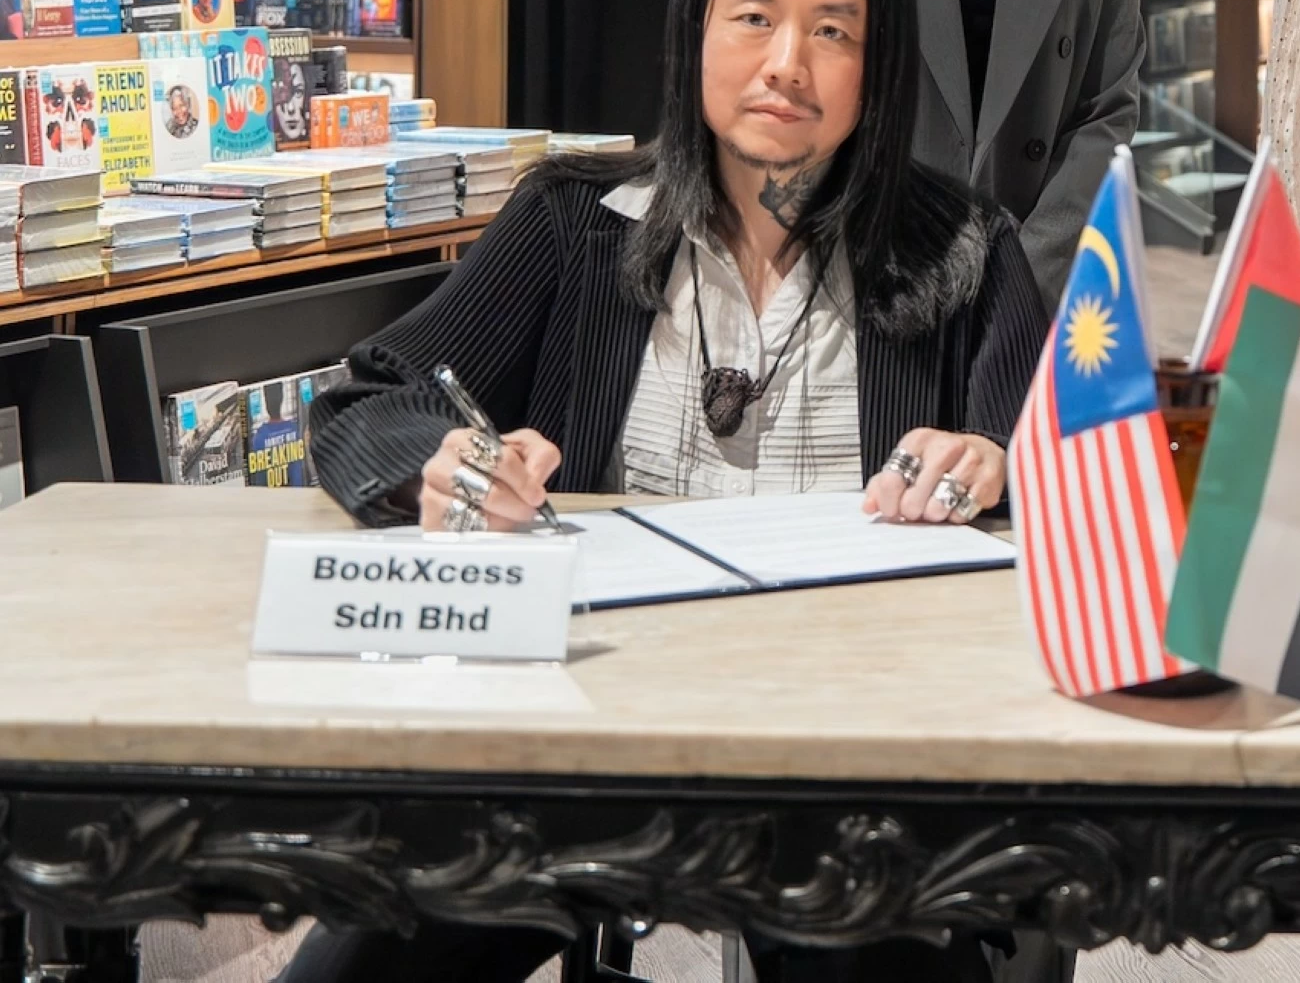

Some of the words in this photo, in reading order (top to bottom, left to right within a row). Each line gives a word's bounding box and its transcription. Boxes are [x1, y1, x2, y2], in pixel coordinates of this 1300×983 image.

[256, 6, 287, 26] FOX
[209, 55, 223, 88] IT
[225, 50, 265, 83] TAKES
[1, 77, 14, 89] OF
[98, 71, 145, 92] FRIEND
[100, 93, 146, 114] AHOLIC
[222, 84, 257, 114] TWO
[353, 109, 371, 126] WE
[57, 154, 91, 167] FACES
[104, 156, 150, 171] ELIZABETH
[119, 172, 136, 184] DAY
[200, 452, 228, 474] David
[248, 440, 305, 474] BREAKING
[267, 465, 288, 488] OUT
[313, 556, 525, 585] BookXcess
[334, 603, 403, 630] Sdn
[419, 606, 490, 632] Bhd
